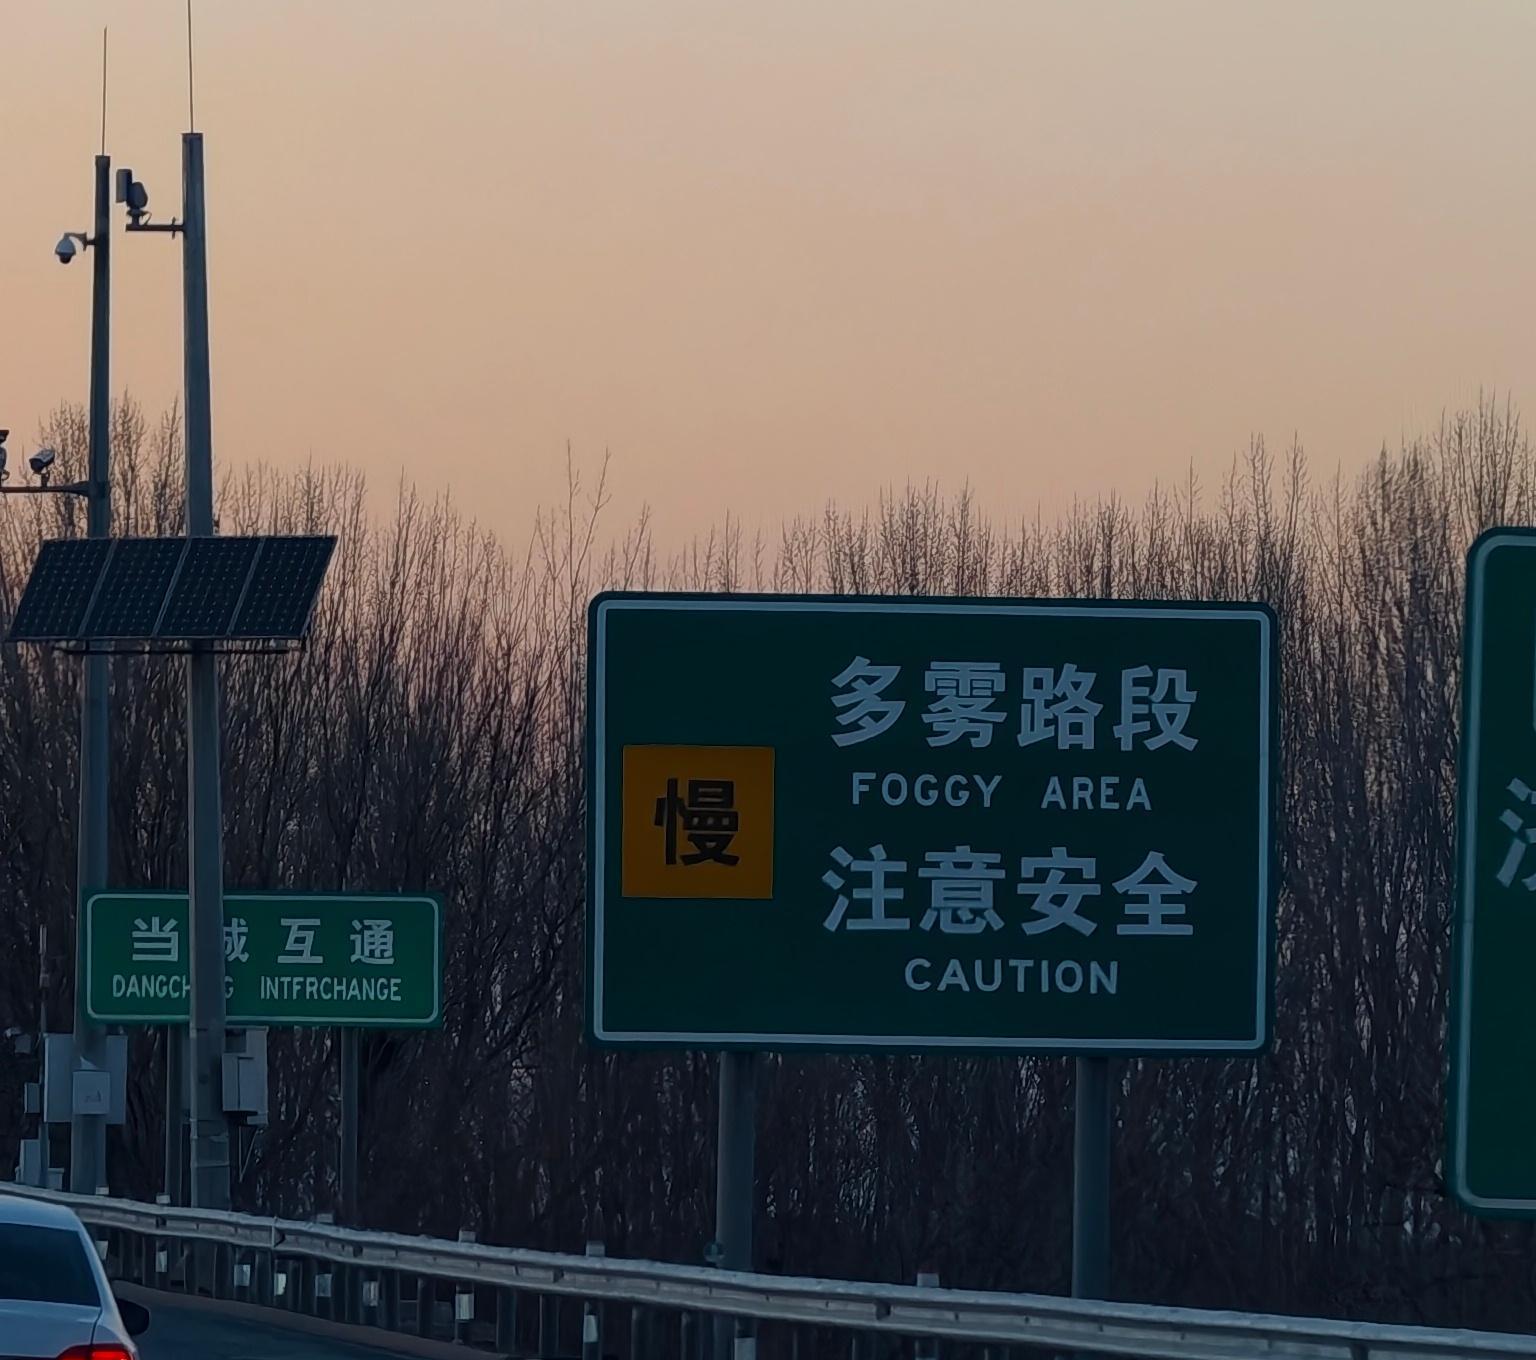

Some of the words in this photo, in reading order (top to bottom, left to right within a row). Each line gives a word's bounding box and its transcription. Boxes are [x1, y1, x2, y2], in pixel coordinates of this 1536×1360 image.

[830, 655, 1199, 752] 多雾路段
[654, 778, 740, 867] 慢
[852, 772, 1003, 808] FOGGY
[1040, 776, 1153, 811] AREA
[821, 843, 1198, 937] 注意安全
[904, 958, 1119, 995] CAUTION
